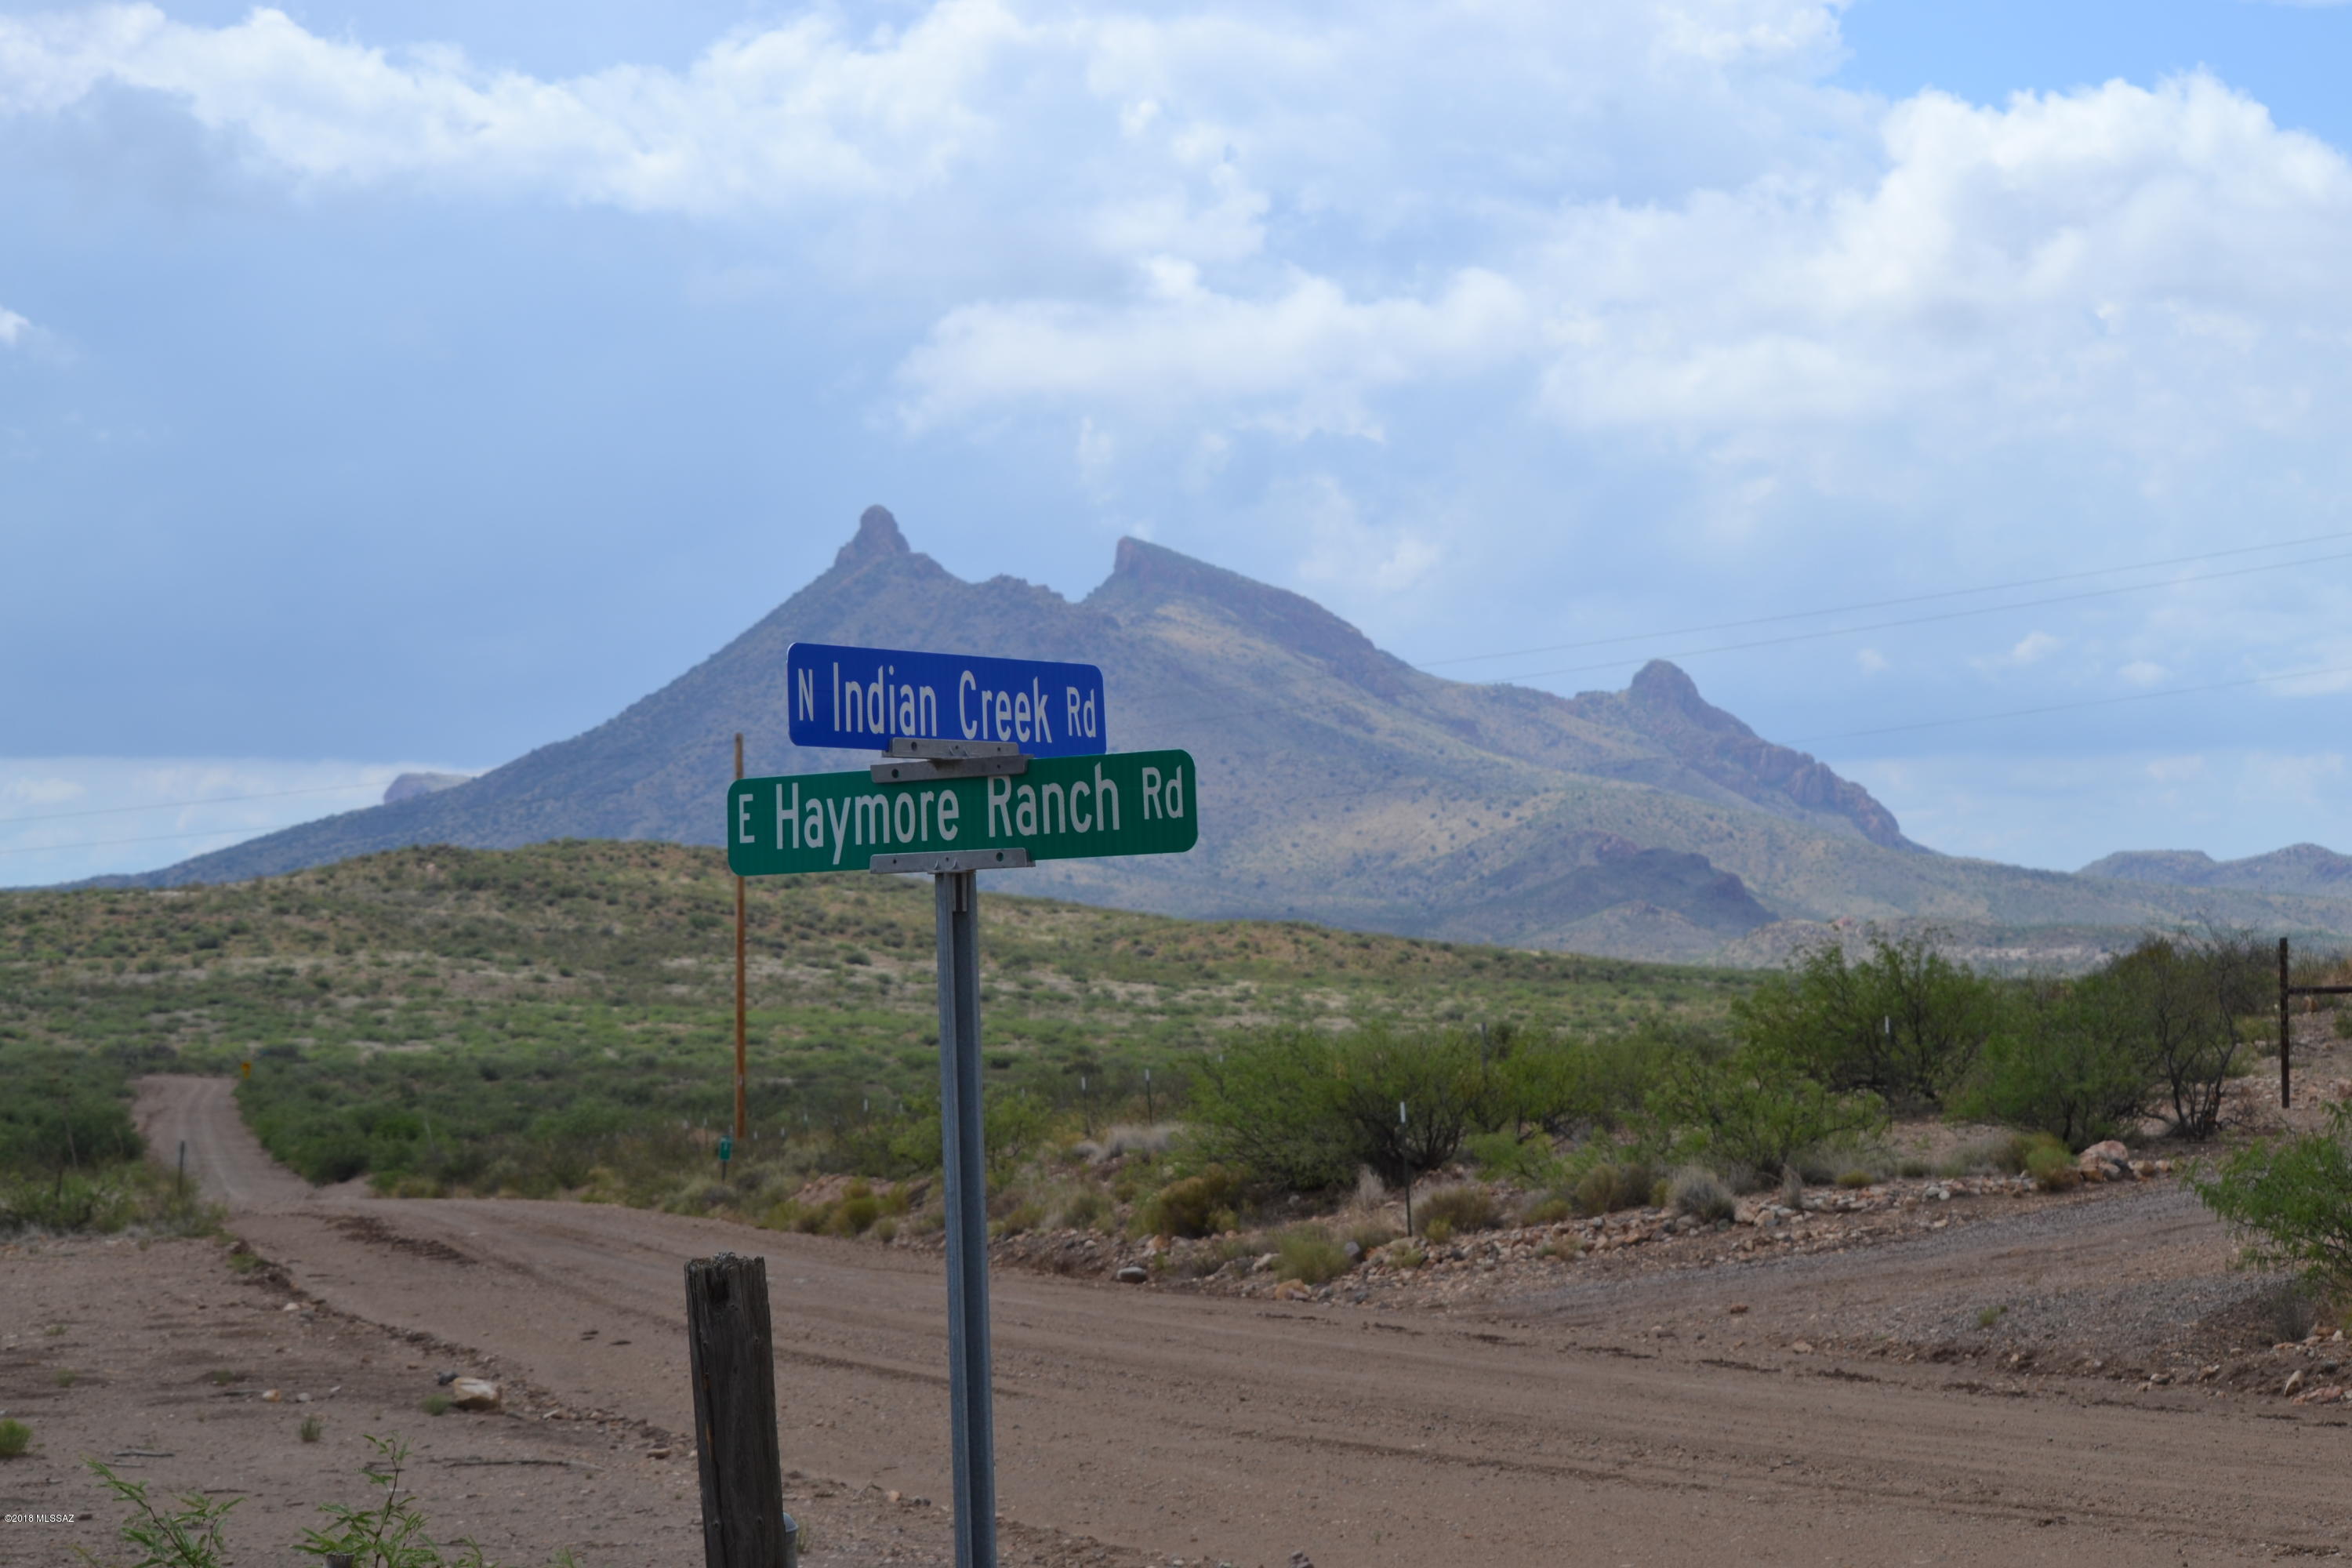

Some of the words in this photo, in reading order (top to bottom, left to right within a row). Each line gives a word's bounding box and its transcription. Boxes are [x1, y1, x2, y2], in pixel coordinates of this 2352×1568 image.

[798, 669, 814, 721] N
[833, 662, 938, 737] Indian
[960, 670, 1052, 743] Creek
[1067, 687, 1097, 738] Rd
[739, 793, 755, 844] E
[776, 782, 960, 865] Haymore
[988, 762, 1120, 837] Ranch
[1142, 765, 1184, 820] Rd
